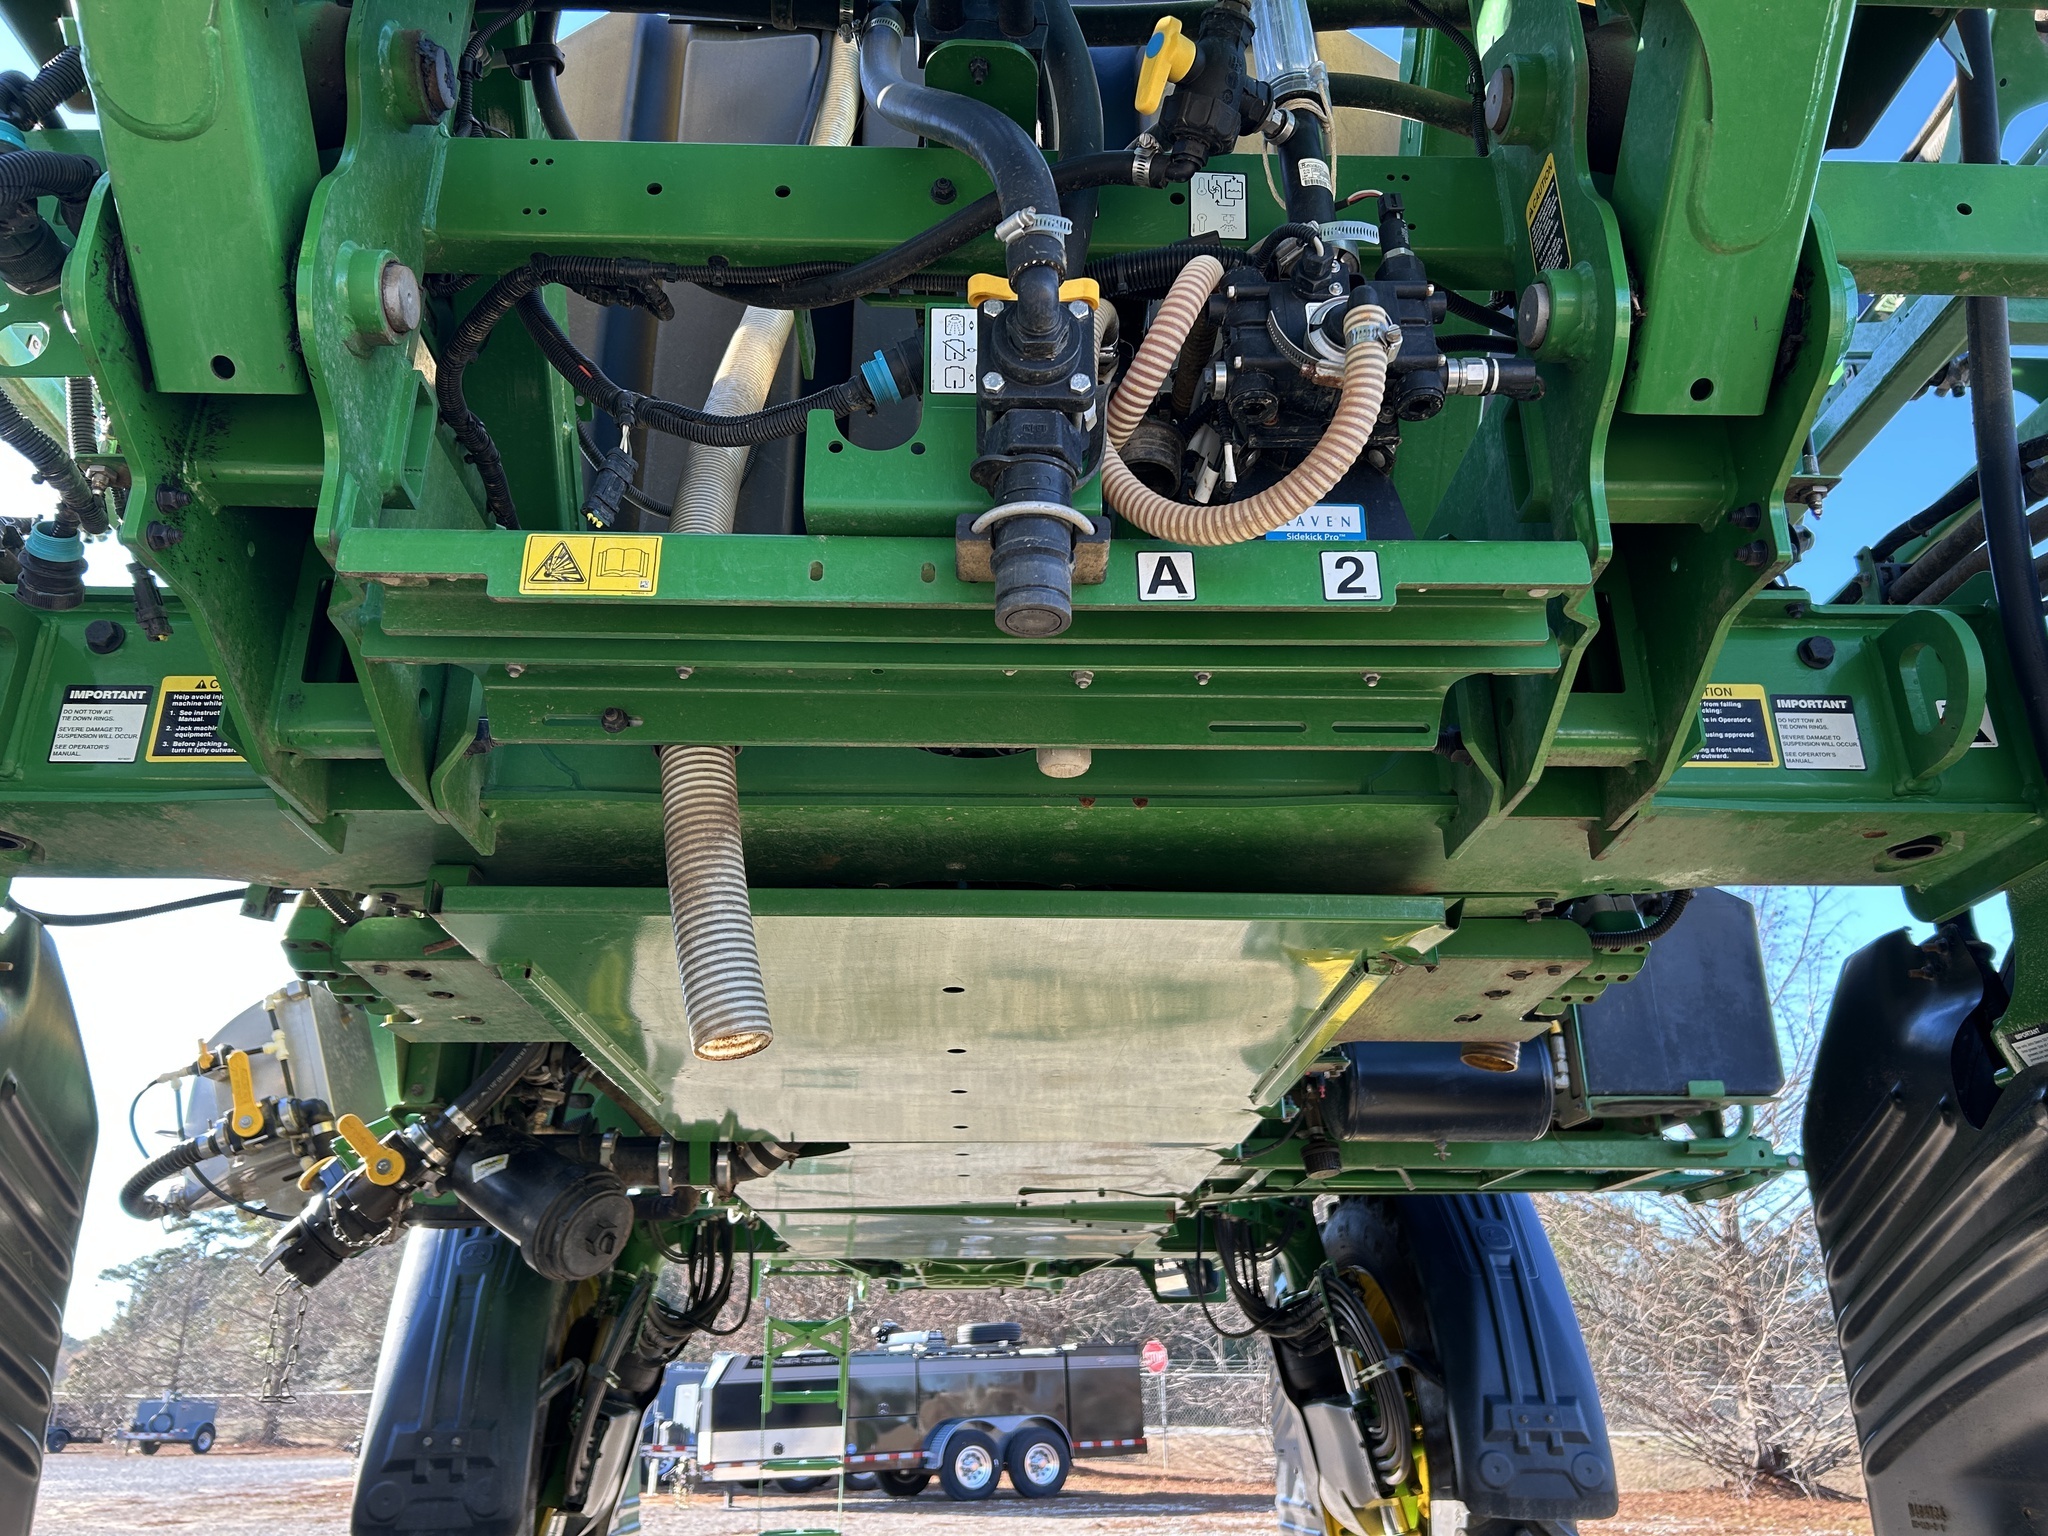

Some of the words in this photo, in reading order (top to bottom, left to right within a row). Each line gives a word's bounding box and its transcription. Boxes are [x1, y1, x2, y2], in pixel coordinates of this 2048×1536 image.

[1532, 161, 1553, 208] CAUTION
[1286, 532, 1323, 540] Sidekick
[1146, 556, 1188, 595] A
[1334, 556, 1367, 594] 2
[69, 690, 147, 700] IMPORTANT
[1705, 687, 1733, 697] TION
[1776, 699, 1847, 709] IMPORTANT
[2014, 1027, 2040, 1040] IMPORTANT
